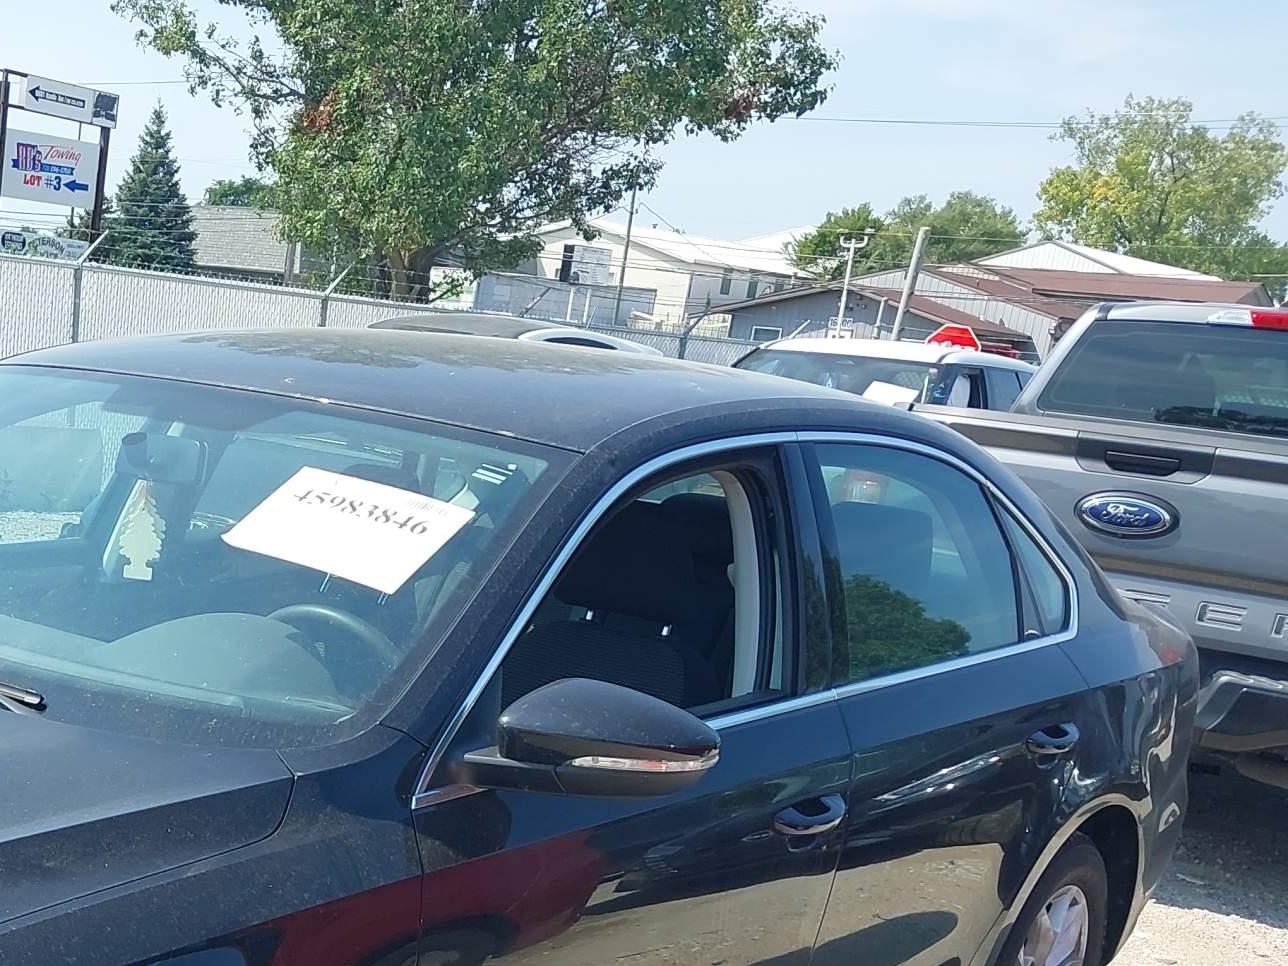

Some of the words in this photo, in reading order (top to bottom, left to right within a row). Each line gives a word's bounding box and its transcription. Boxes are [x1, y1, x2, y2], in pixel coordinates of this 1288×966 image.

[39, 145, 81, 166] Towing
[23, 173, 42, 187] LOT
[44, 175, 62, 191] #3
[293, 488, 429, 536] 45983846
[1102, 502, 1150, 527] Ford
